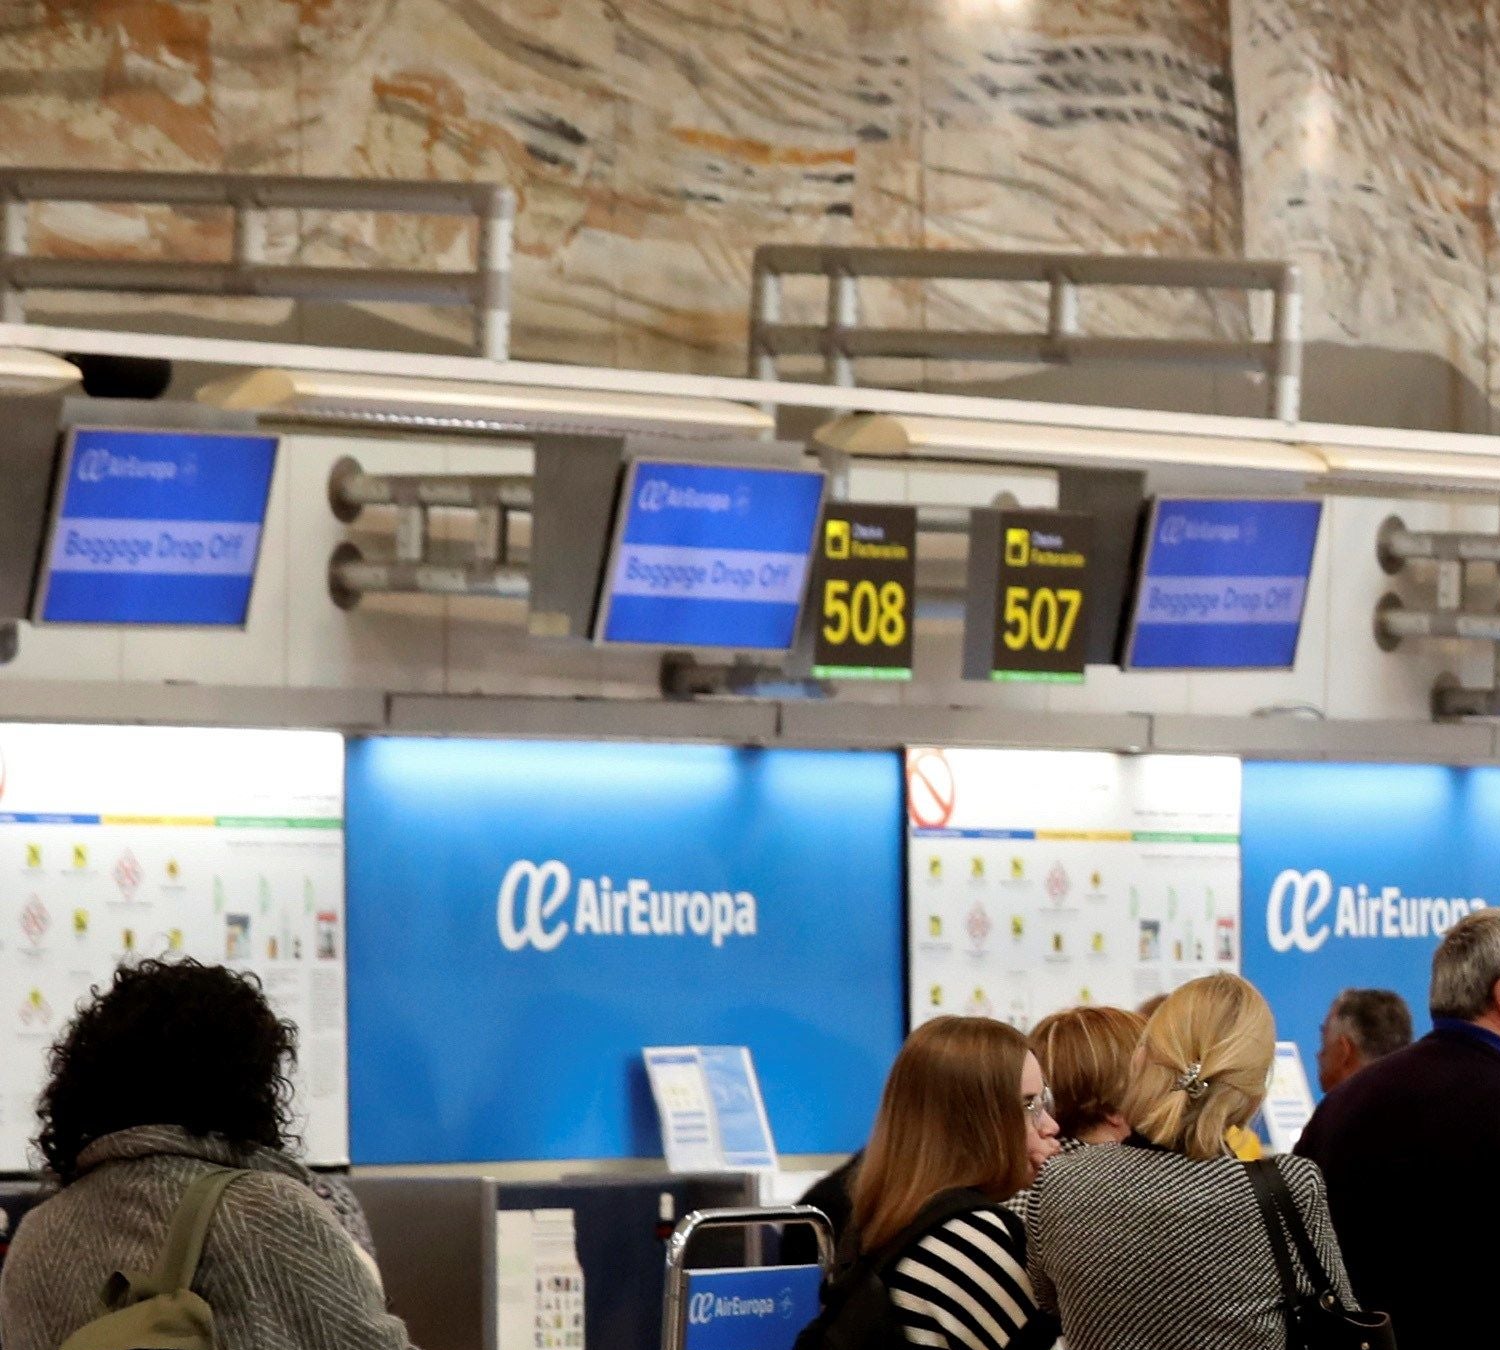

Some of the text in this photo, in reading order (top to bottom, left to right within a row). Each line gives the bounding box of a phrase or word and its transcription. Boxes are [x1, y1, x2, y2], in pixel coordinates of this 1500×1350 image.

[65, 529, 242, 565] Baggage Drop Off
[626, 556, 792, 591] Baggage Drop Off
[823, 579, 906, 647] 508
[1002, 586, 1082, 651] 507
[574, 877, 757, 946] AirEuropa
[1334, 883, 1488, 938] AirEurop
[715, 1297, 774, 1317] AirEuropa
